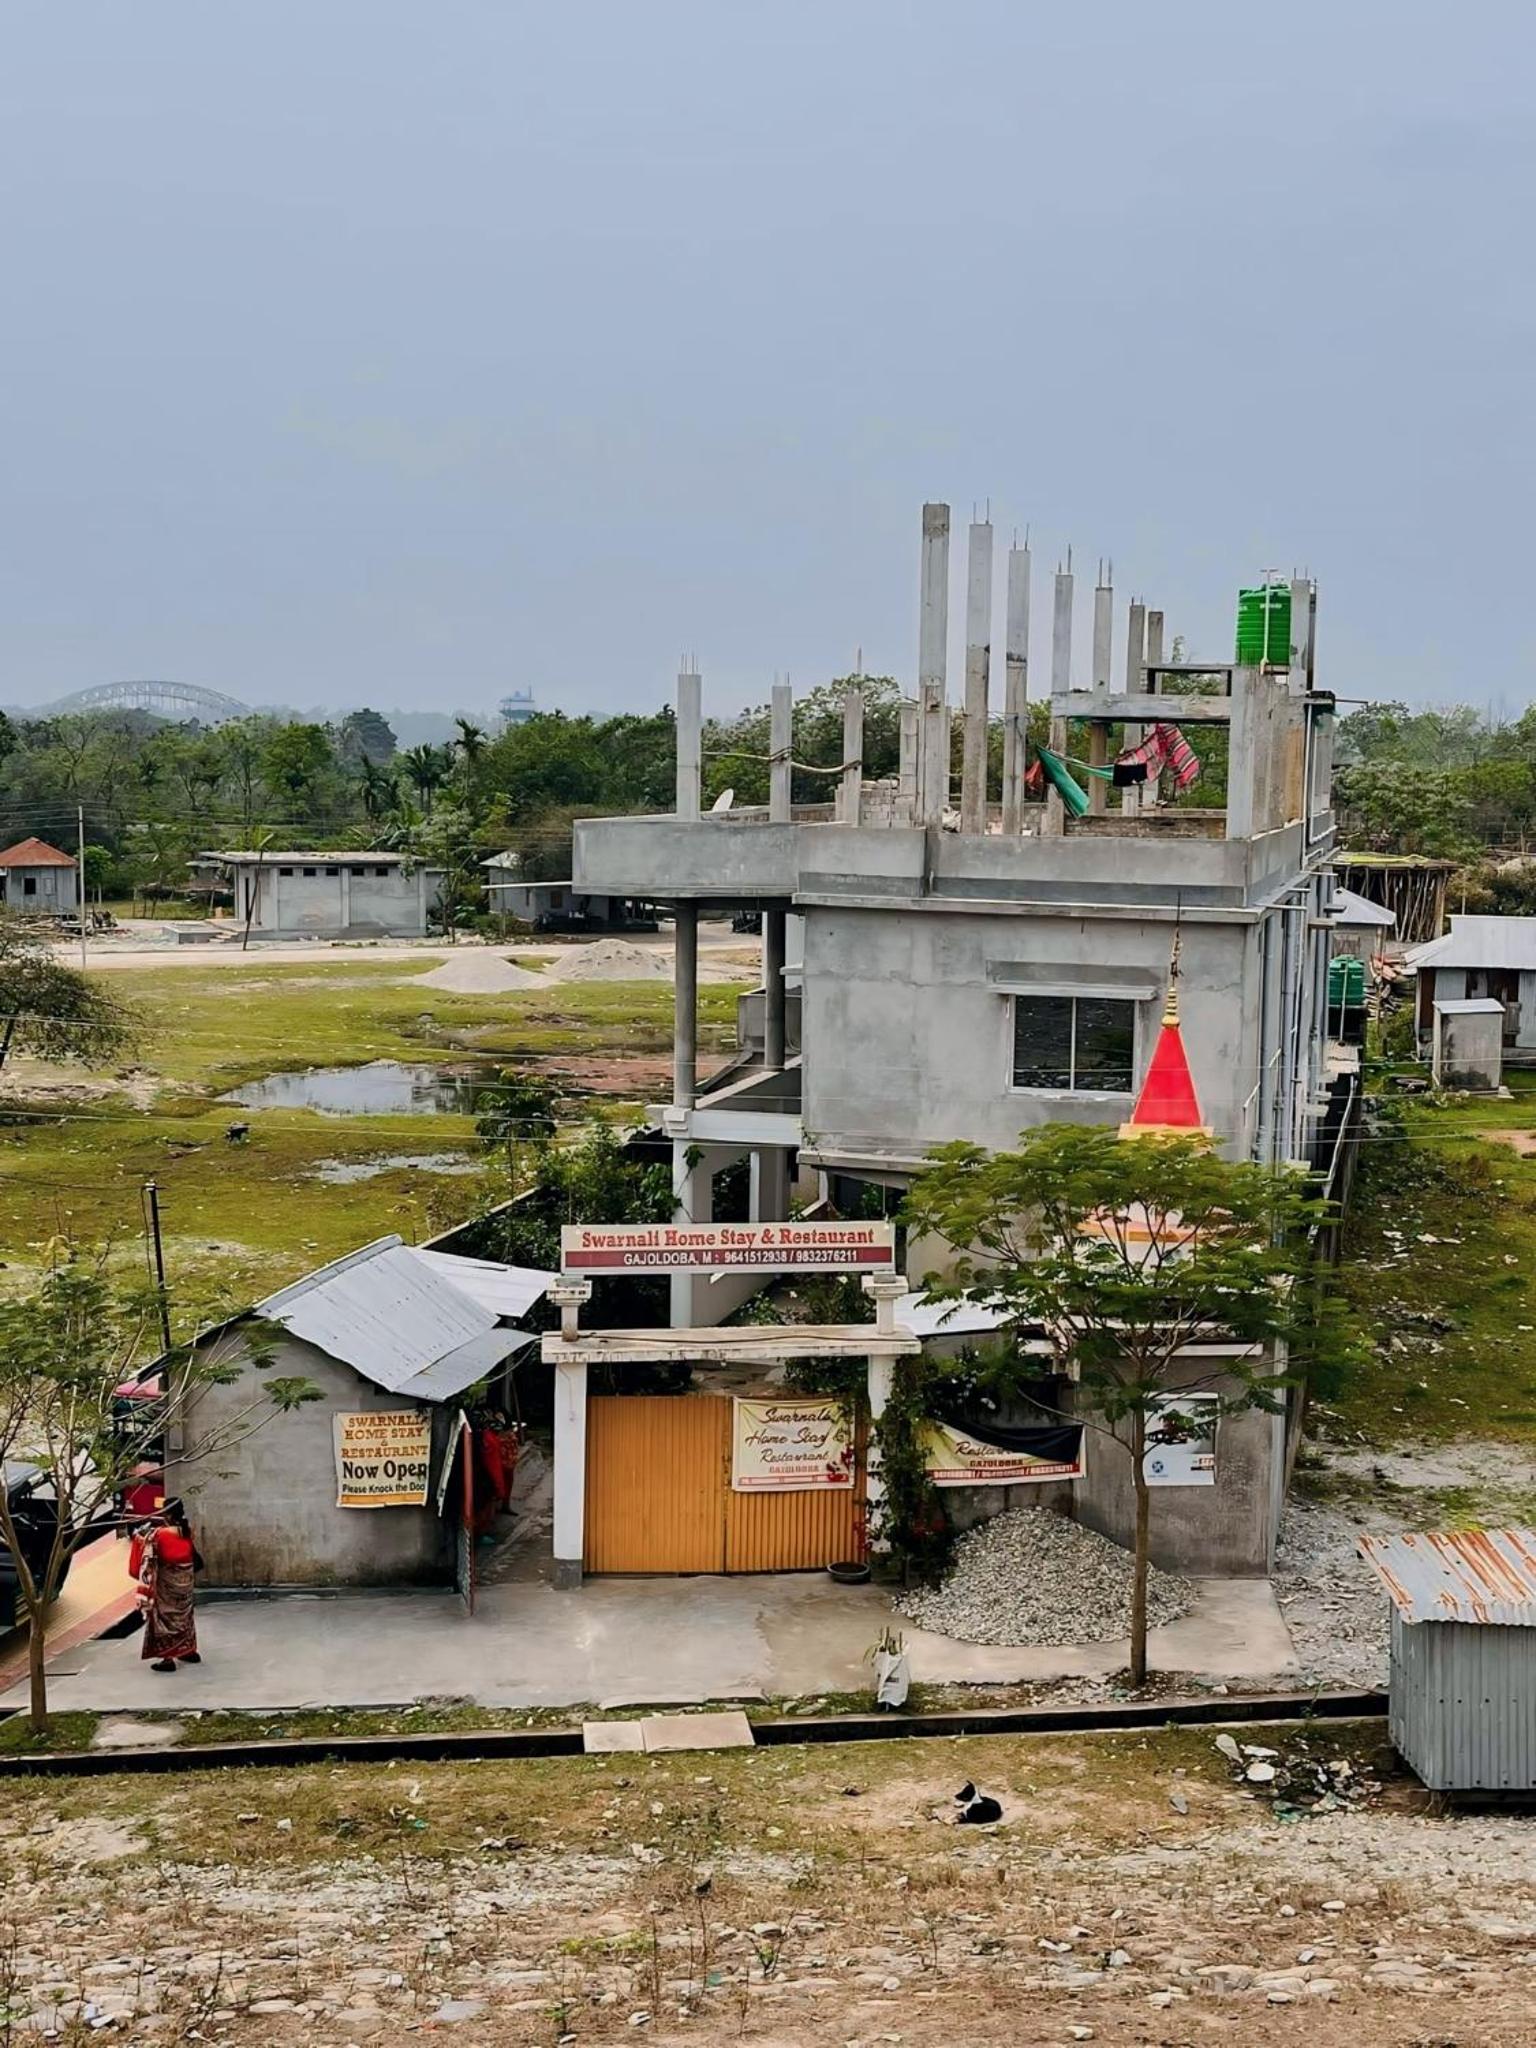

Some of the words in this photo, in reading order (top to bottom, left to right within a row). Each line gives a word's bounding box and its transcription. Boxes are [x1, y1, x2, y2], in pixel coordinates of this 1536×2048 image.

[582, 1230, 659, 1247] Swarnali
[665, 1229, 716, 1246] Home
[720, 1229, 756, 1248] Stay
[761, 1228, 774, 1244] &
[780, 1228, 874, 1244] Restaurant
[724, 1251, 787, 1263] 9641512938
[796, 1250, 857, 1262] 9832376211
[345, 1428, 387, 1440] HOME
[391, 1427, 424, 1438] STAY
[745, 1429, 788, 1447] Home
[791, 1427, 829, 1447] Stay
[341, 1445, 428, 1458] RESTAURANT
[760, 1448, 829, 1462] Restaurant
[342, 1461, 379, 1479] Now
[383, 1460, 427, 1480] Open
[342, 1484, 367, 1493] Please
[369, 1484, 393, 1493] Knock
[395, 1483, 408, 1492] the
